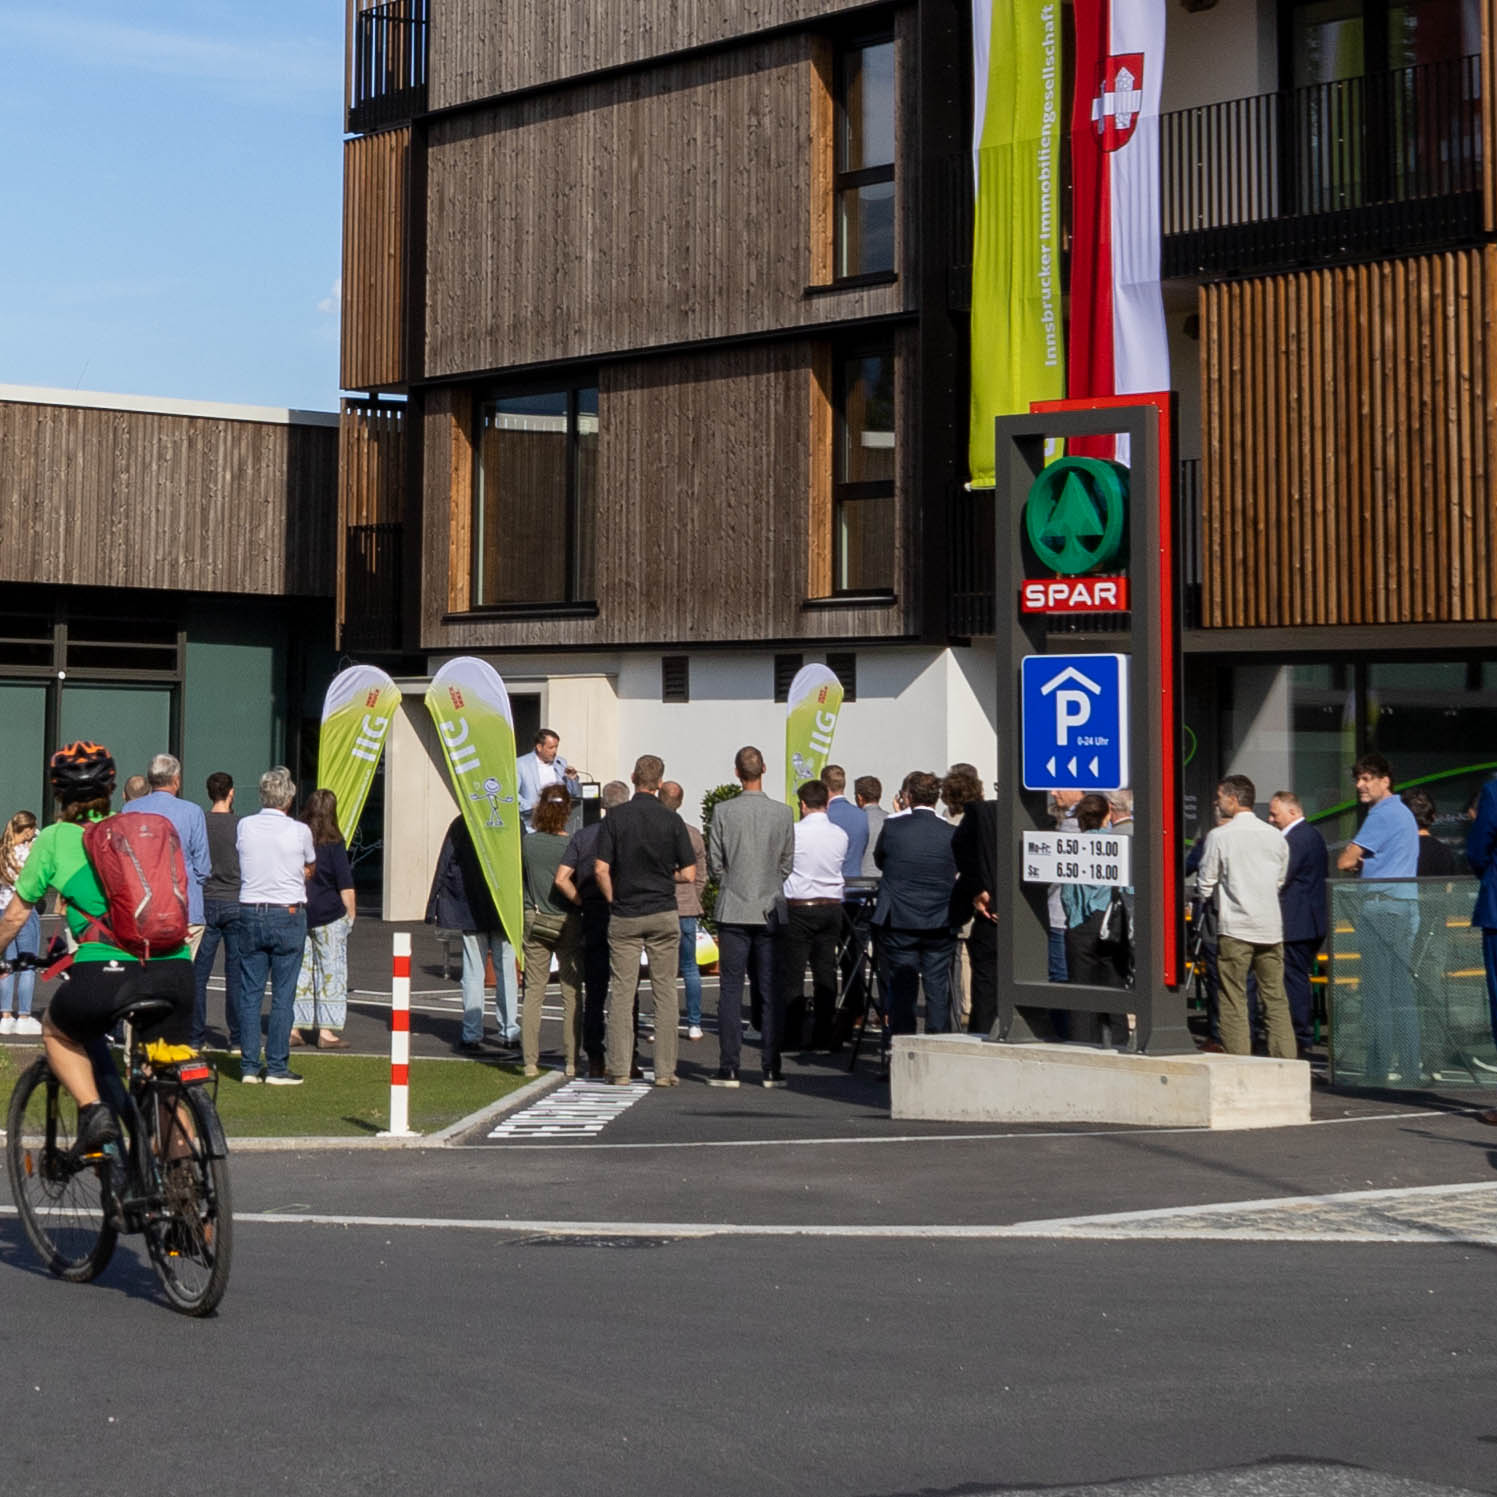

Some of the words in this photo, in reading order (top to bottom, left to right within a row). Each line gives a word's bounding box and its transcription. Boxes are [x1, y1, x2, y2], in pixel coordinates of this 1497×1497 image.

[1038, 4, 1056, 239] Immobiliengesellschaft
[1038, 244, 1057, 366] Innsbrucker
[1025, 582, 1117, 608] SPAR
[352, 714, 389, 762] IIG
[809, 710, 836, 755] IIG
[1056, 690, 1091, 746] P
[1095, 736, 1109, 746] Uhr
[1056, 838, 1079, 855] 6.50
[1089, 840, 1119, 857] 19.00
[1056, 862, 1079, 878] 6.50
[1089, 864, 1119, 881] 18.00
